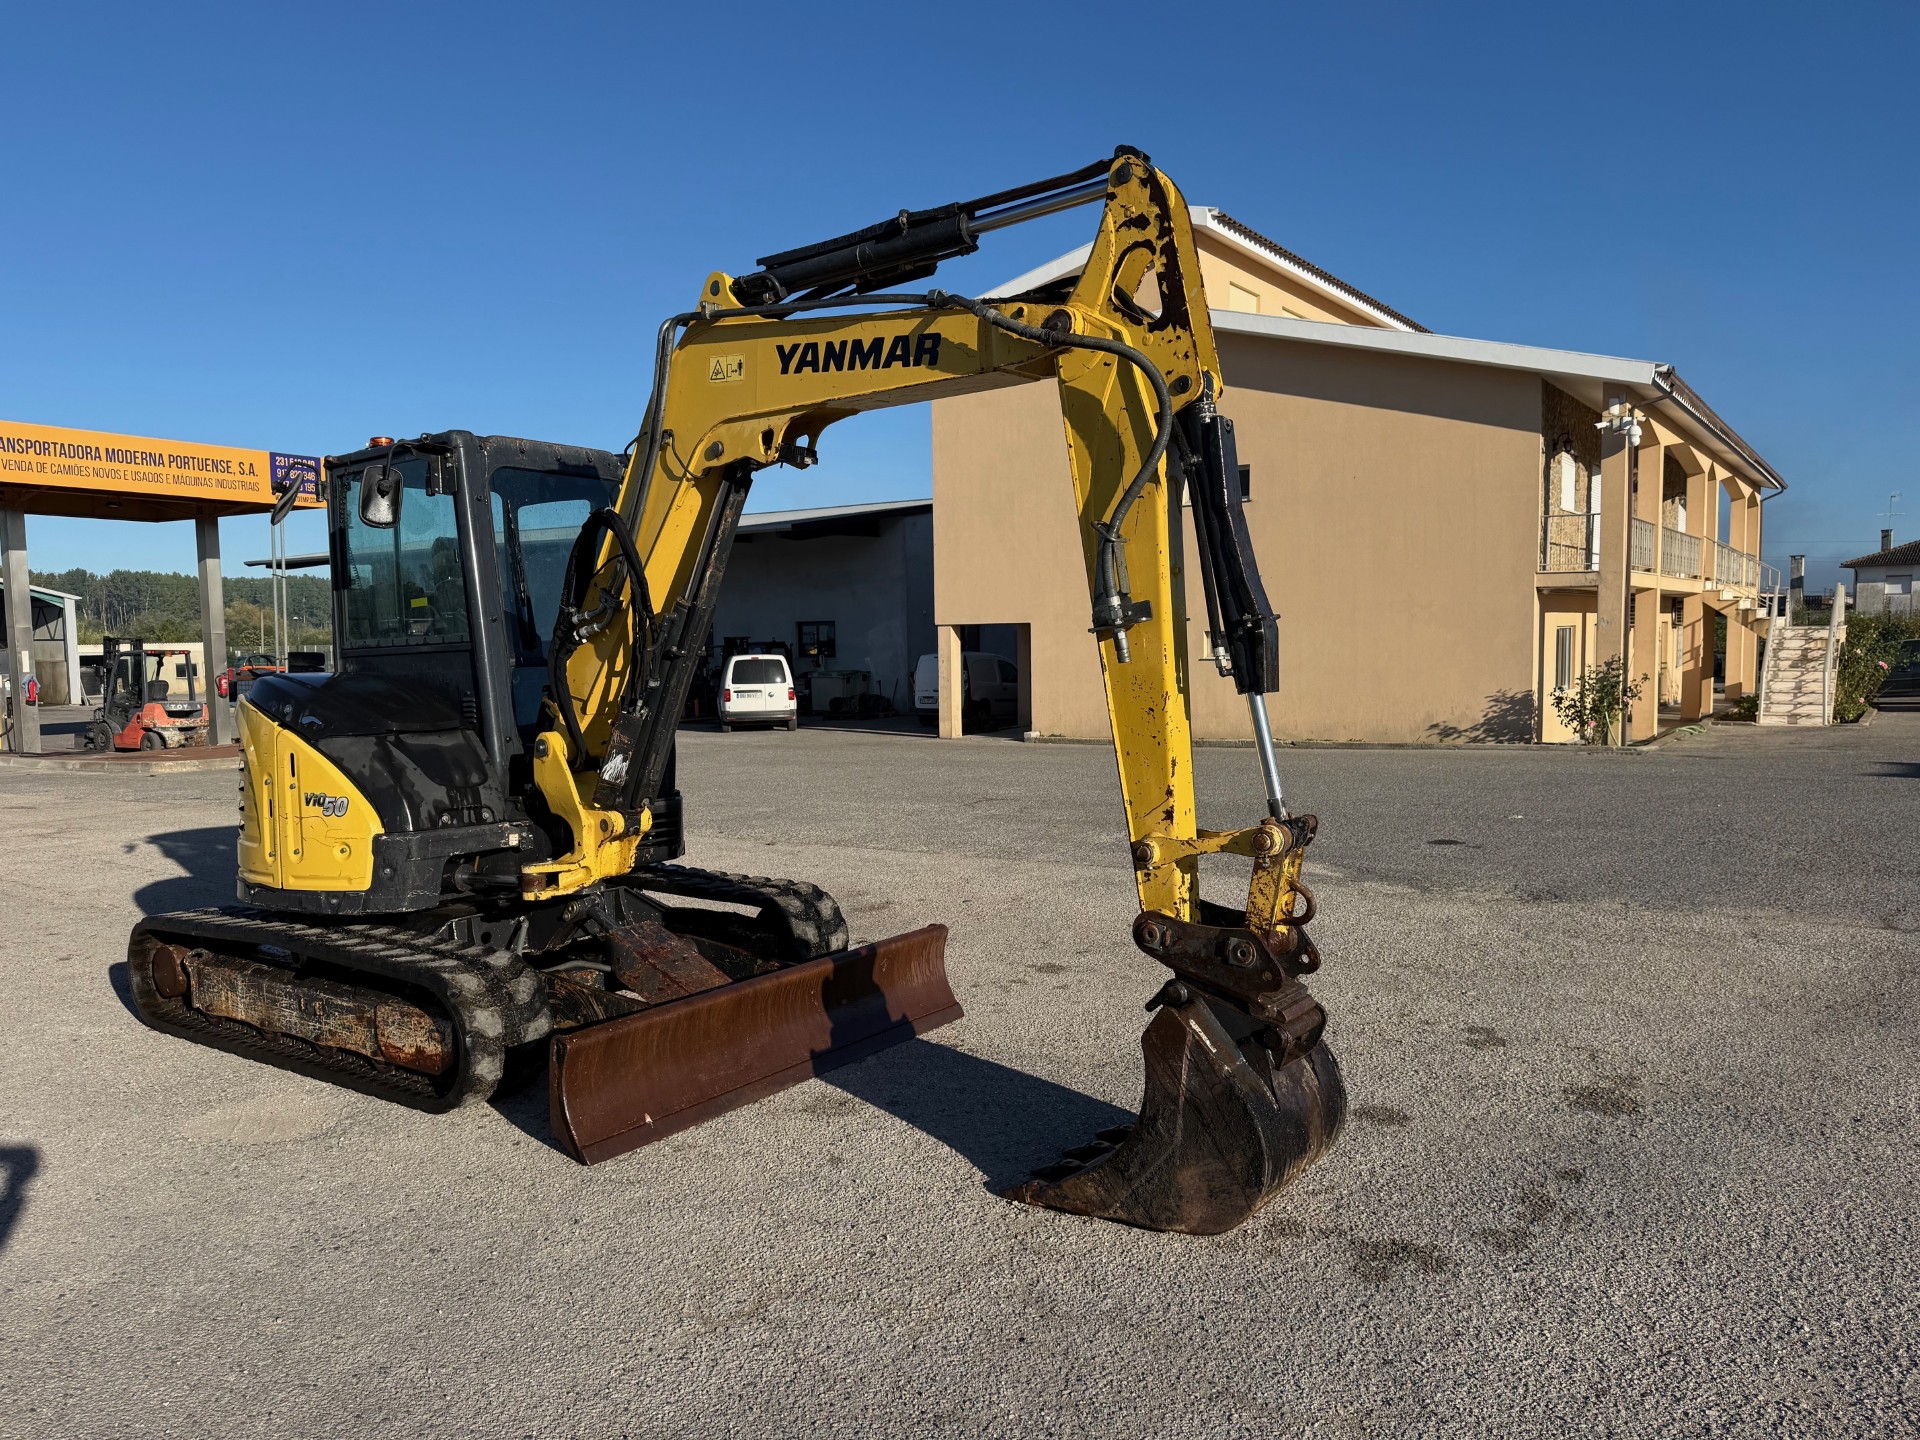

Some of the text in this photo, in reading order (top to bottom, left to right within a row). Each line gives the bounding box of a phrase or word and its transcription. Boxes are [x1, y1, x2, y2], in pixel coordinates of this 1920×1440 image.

[776, 332, 941, 375] YANMAR
[0, 436, 259, 477] ANSPORTADORA MODERNA PORTUENSE, S.A.
[275, 456, 288, 467] 231
[1, 458, 260, 492] VENDA DE CAMIÕES NOVOS E USADOS E MÁQUINAS INDUSTRIAIS
[303, 471, 316, 481] 346
[304, 482, 316, 492] 195
